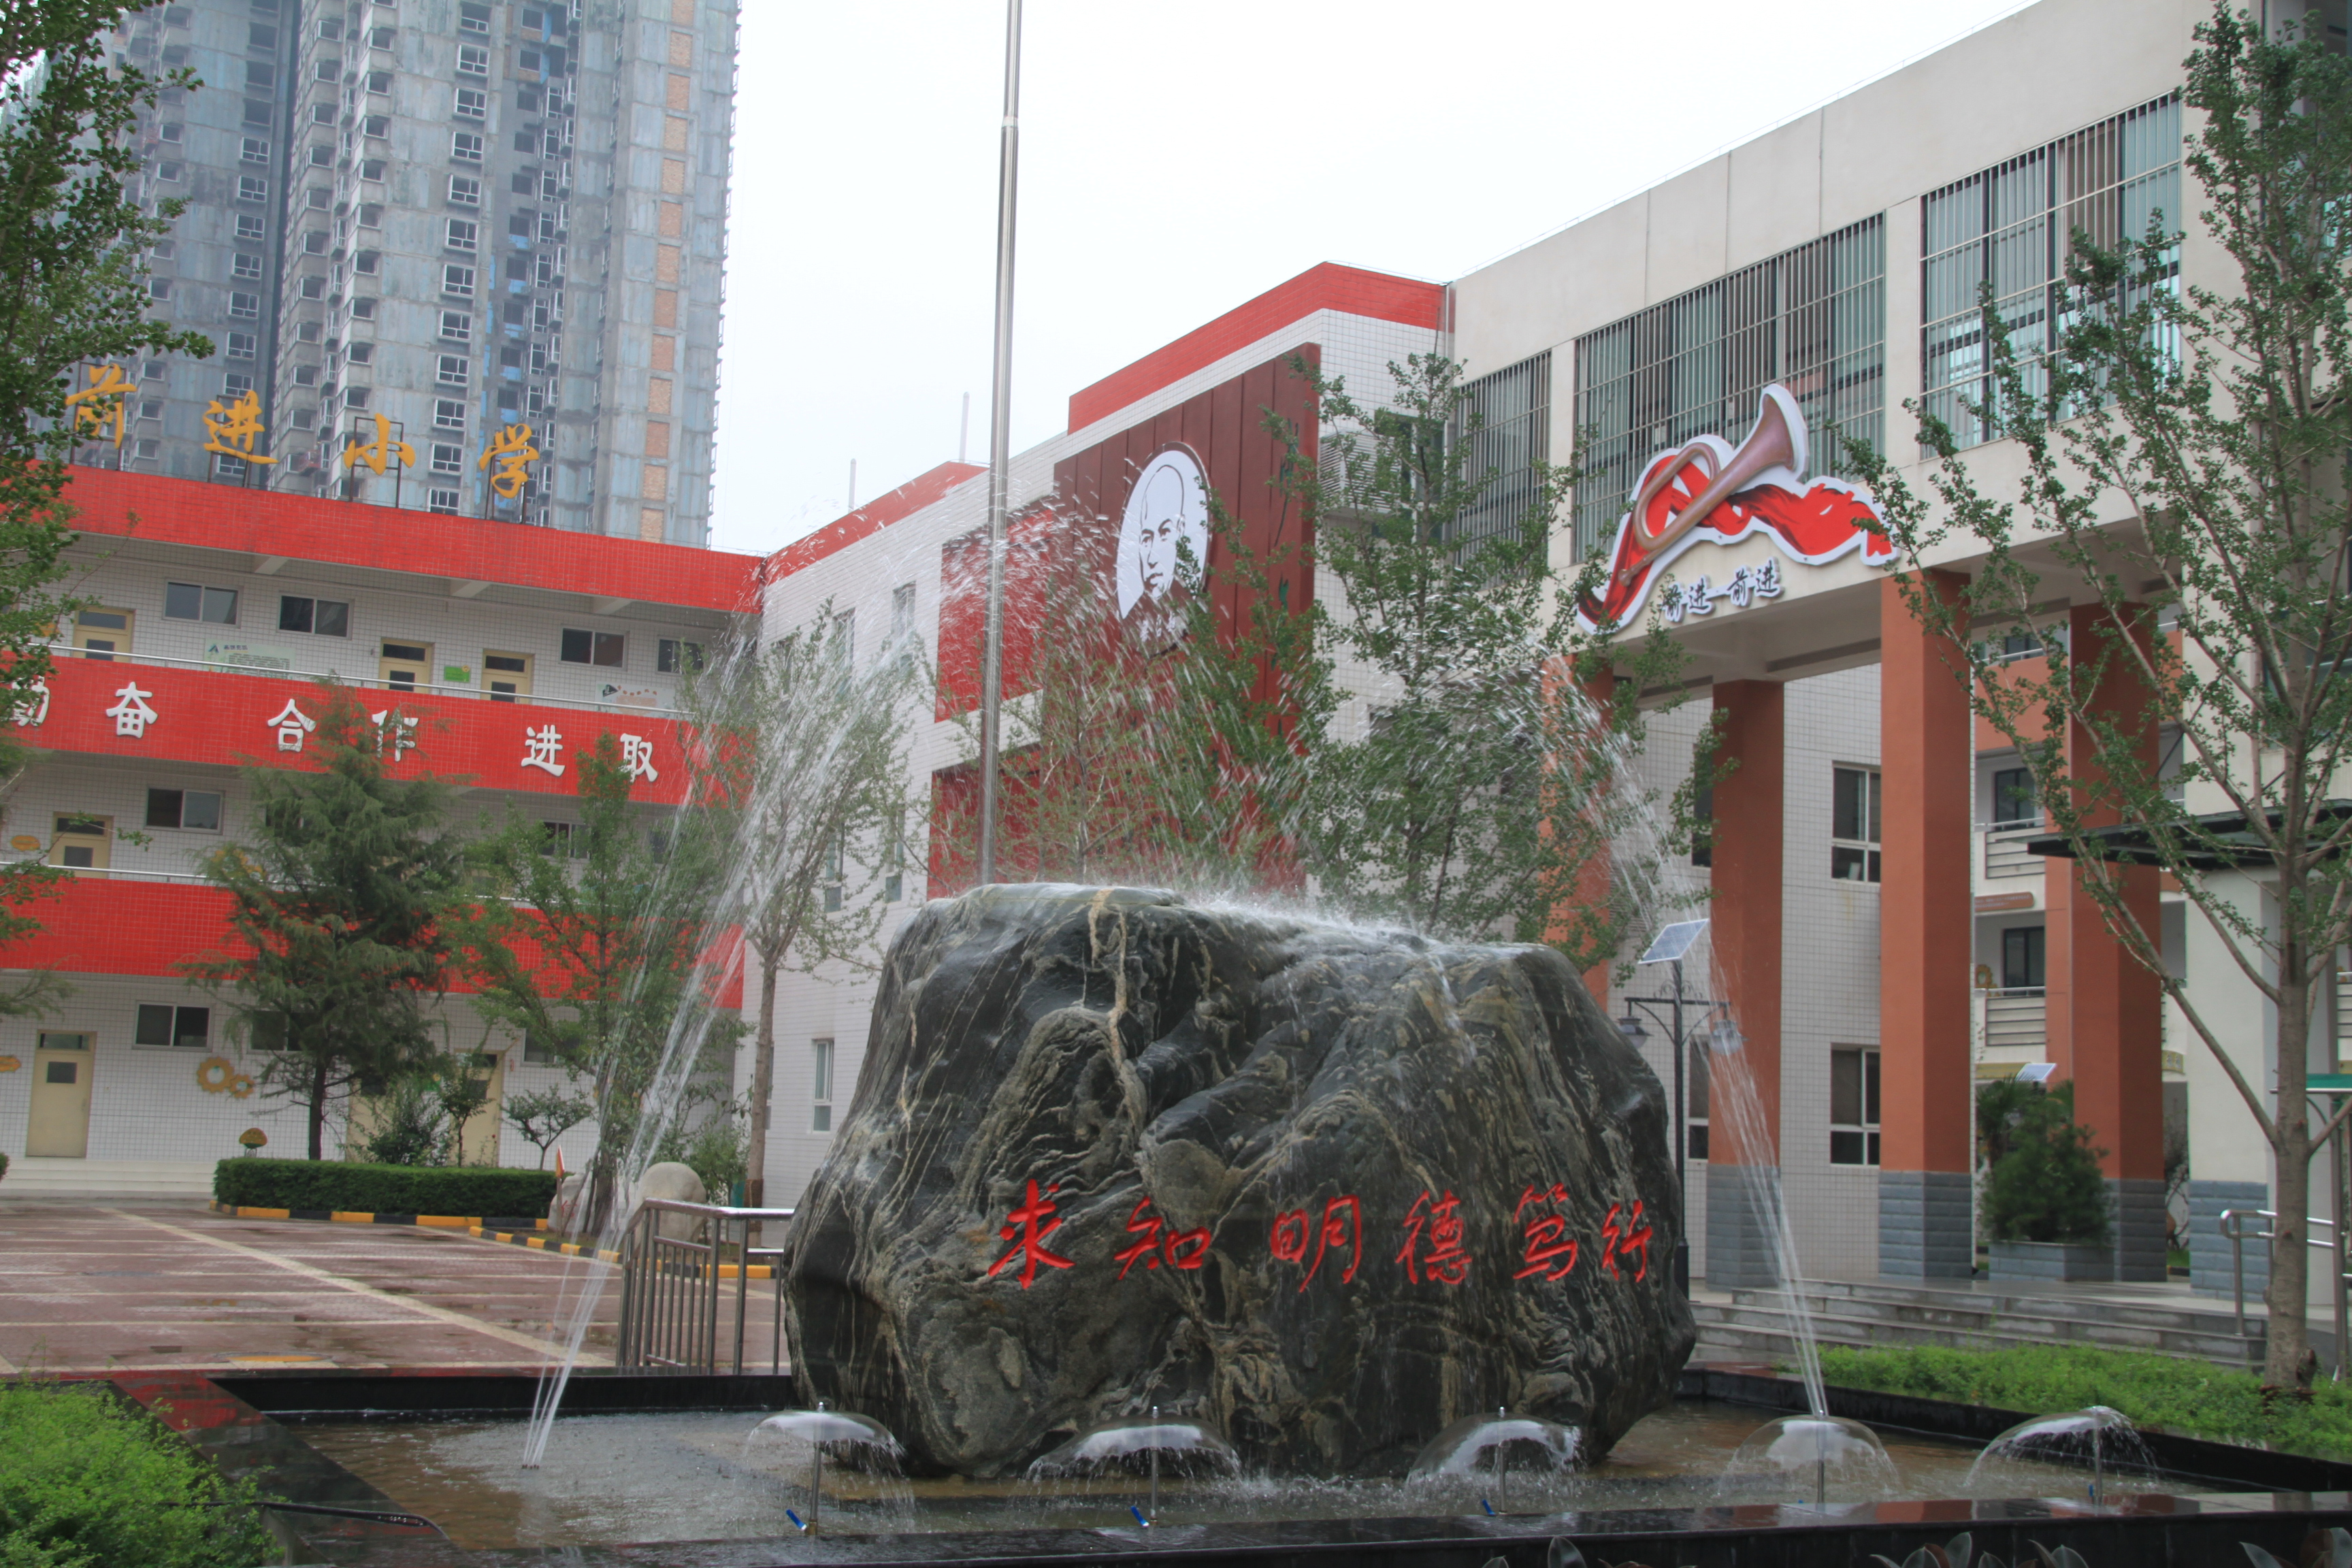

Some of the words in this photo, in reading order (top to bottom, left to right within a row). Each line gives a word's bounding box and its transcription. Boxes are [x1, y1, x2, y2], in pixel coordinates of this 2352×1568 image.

[65, 363, 540, 499] 前进小学
[1662, 578, 1710, 617] 前进
[1727, 559, 1778, 603] 前进
[267, 698, 419, 762] 合作
[521, 724, 658, 783] 进取
[988, 1179, 1653, 1292] 求知明德笃行
